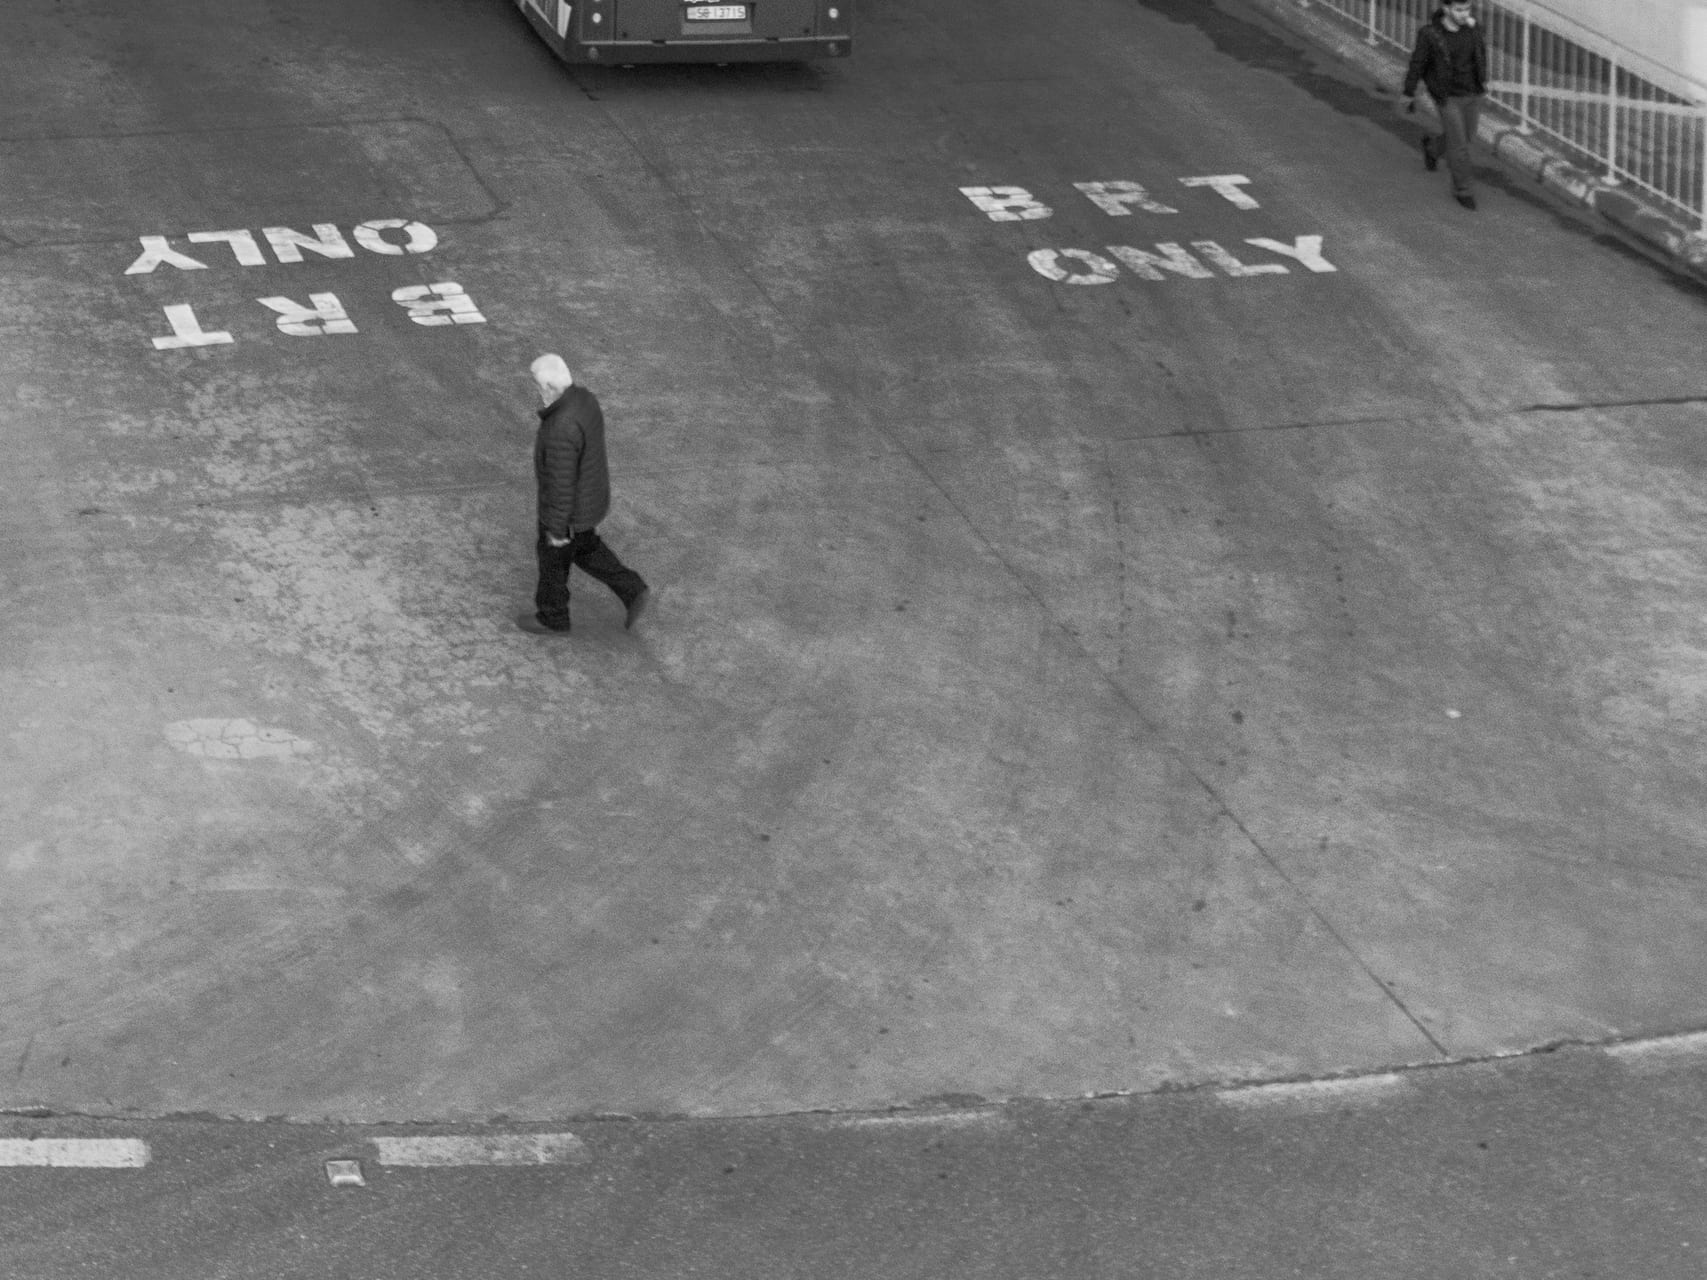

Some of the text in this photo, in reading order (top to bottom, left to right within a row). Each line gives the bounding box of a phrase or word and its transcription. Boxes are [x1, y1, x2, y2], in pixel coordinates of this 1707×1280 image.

[958, 173, 1260, 221] BRT
[124, 219, 438, 275] ONLY
[1027, 234, 1338, 285] ONLY
[152, 282, 487, 350] BRT
